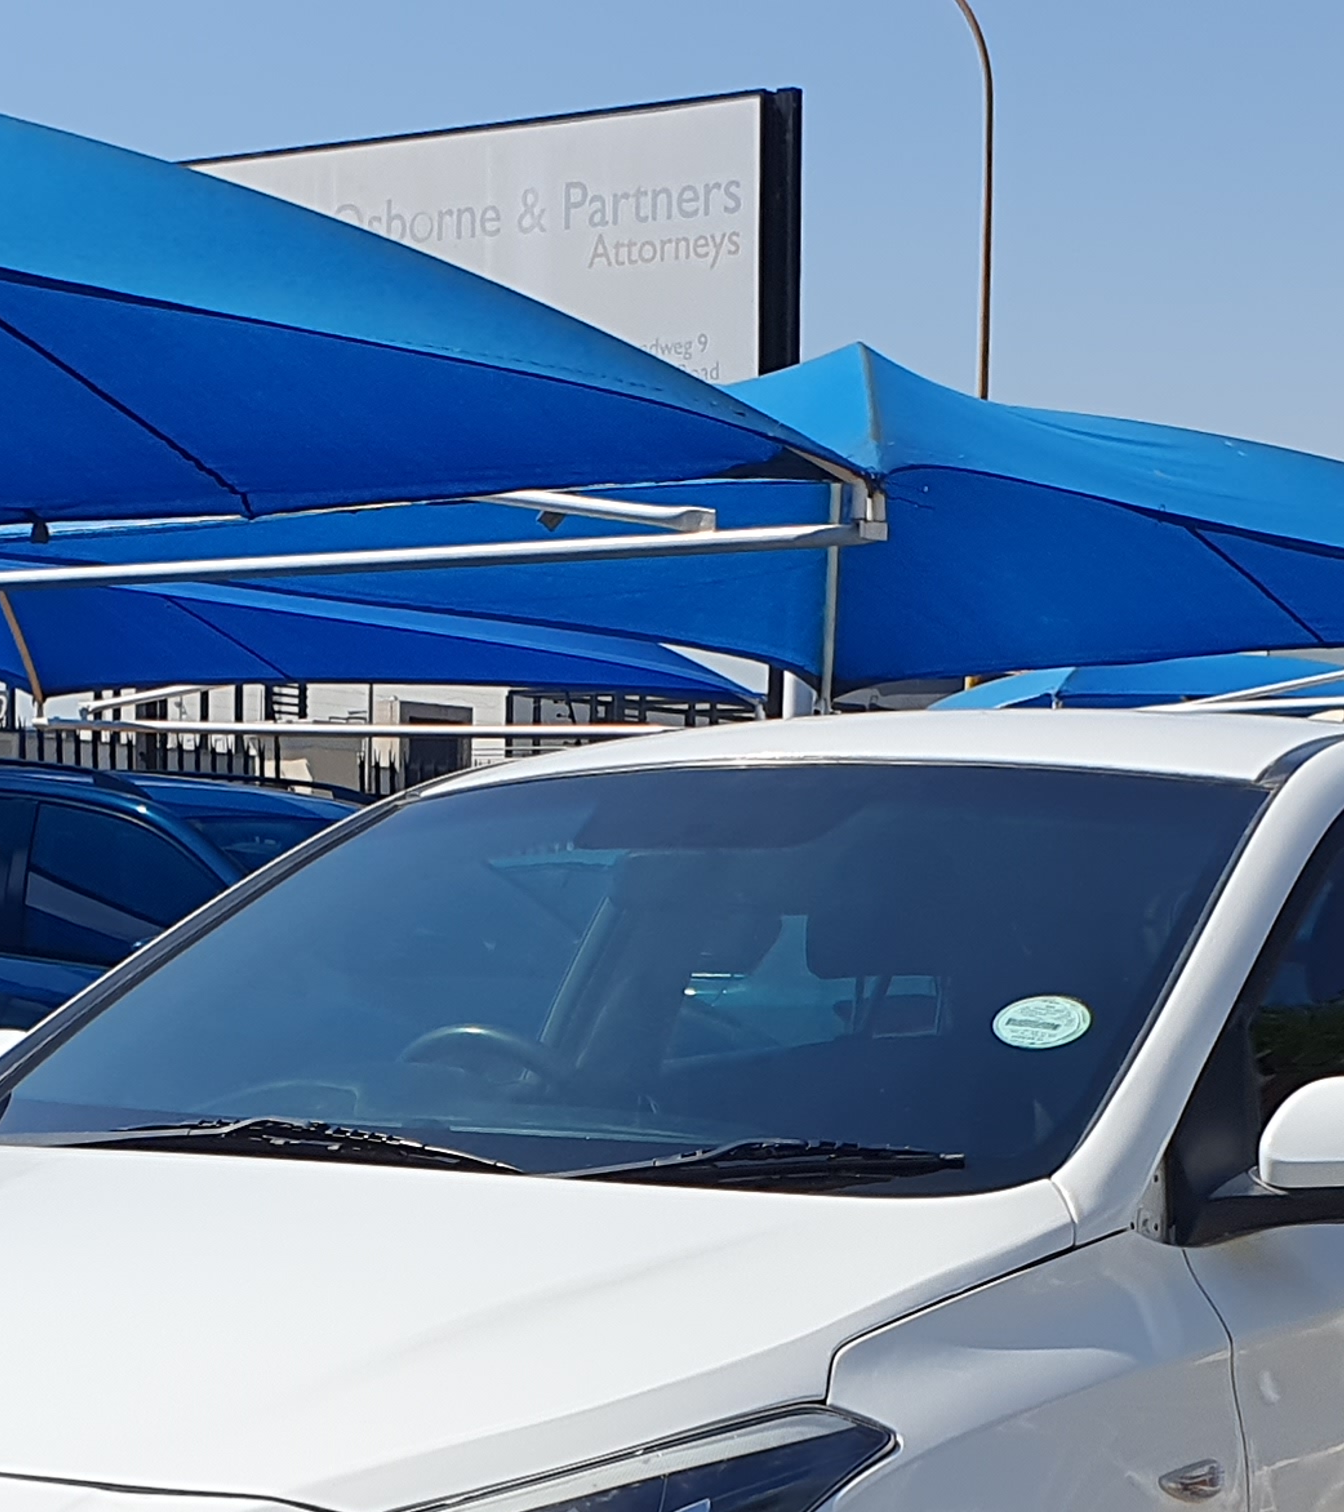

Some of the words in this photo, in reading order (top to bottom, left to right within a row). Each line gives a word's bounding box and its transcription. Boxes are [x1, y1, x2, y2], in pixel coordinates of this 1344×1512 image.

[517, 187, 547, 234] &
[563, 179, 743, 231] Partners
[587, 230, 741, 270] Attorneys
[697, 333, 708, 353] 9
